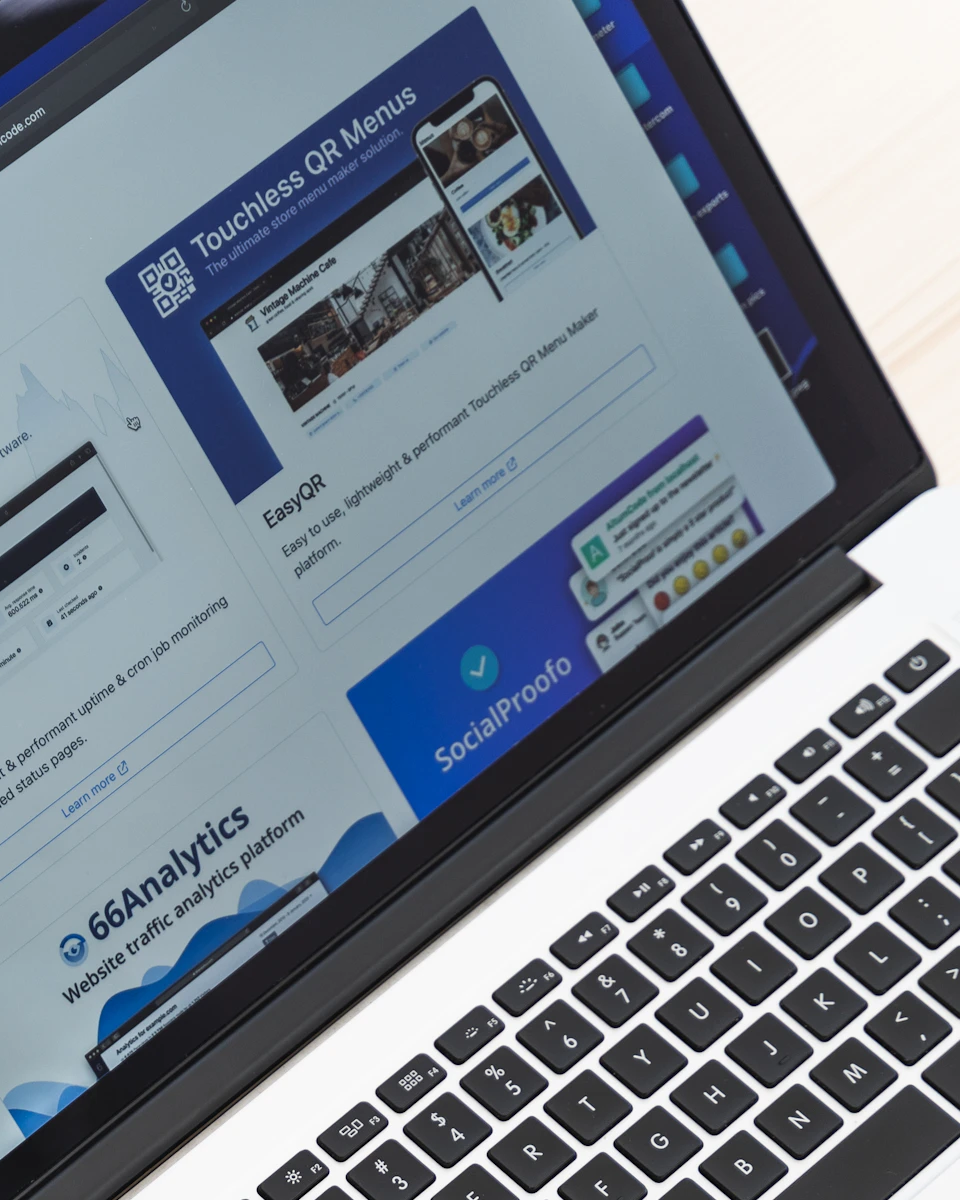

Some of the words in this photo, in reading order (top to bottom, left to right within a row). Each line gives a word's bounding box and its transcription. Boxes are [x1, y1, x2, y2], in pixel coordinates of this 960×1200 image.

[189, 170, 305, 257] Touchless
[304, 138, 343, 174] QR
[339, 86, 416, 150] Menus
[204, 257, 228, 276] The
[228, 225, 270, 261] ultimate
[270, 205, 298, 229] store
[297, 183, 328, 209] menu
[327, 158, 359, 187] maker
[359, 128, 403, 162] solution.
[259, 293, 289, 316] Vintage
[287, 270, 319, 296] Machine
[318, 257, 337, 273] Cafe
[281, 533, 308, 557] Easy
[308, 523, 321, 537] to
[321, 508, 346, 527] use,
[343, 460, 402, 509] lightweight
[401, 452, 413, 465] &
[412, 407, 470, 459] performant
[467, 369, 521, 411] Touchless
[519, 354, 538, 373] QR
[536, 333, 568, 359] Menu
[566, 308, 598, 337] Maker
[453, 487, 482, 511] Learn
[481, 468, 506, 490] more
[262, 473, 326, 529] EasyQR
[293, 538, 341, 579] platform.
[67, 597, 88, 615] seconds
[87, 590, 98, 600] ago
[5, 759, 17, 772] &
[16, 711, 78, 766] performant
[77, 683, 115, 716] uptime
[115, 673, 127, 686] &
[127, 655, 152, 678] cron
[150, 640, 170, 661] job
[170, 595, 229, 644] monitoring
[434, 657, 572, 772] SocialProofo
[15, 762, 50, 793] status
[49, 736, 87, 769] pages.
[61, 792, 91, 818] Learn
[90, 772, 116, 796] more
[88, 806, 249, 940] 66Analytics
[852, 868, 867, 883] P
[61, 952, 126, 1004] Website
[125, 913, 173, 955] traffic
[173, 860, 239, 918] analytics
[239, 809, 305, 869] platform
[726, 898, 740, 910] 9
[799, 913, 817, 928] O
[601, 924, 612, 934] F7
[671, 944, 687, 957] 8
[869, 952, 888, 963] L
[543, 971, 555, 981] F6
[615, 988, 629, 1003] 7
[814, 993, 835, 1010] K
[689, 1003, 709, 1019] U
[116, 1035, 138, 1055] Analytics
[137, 1029, 146, 1037] for
[145, 1004, 177, 1031] example.com
[487, 1017, 499, 1028] F5
[564, 1035, 577, 1048] 6
[764, 1041, 777, 1055] J
[633, 1049, 651, 1064] Y
[428, 1067, 439, 1077] F4
[843, 1064, 867, 1083] M
[505, 1080, 521, 1095] 5
[704, 1086, 725, 1104] H
[578, 1096, 595, 1111] T
[369, 1116, 380, 1125] F3
[788, 1110, 810, 1129] N
[451, 1128, 465, 1141] 4
[651, 1133, 669, 1149] G
[523, 1145, 543, 1160] R
[310, 1163, 323, 1174] F2
[734, 1159, 753, 1175] B
[392, 1176, 408, 1190] 3
[595, 1180, 608, 1196] F
